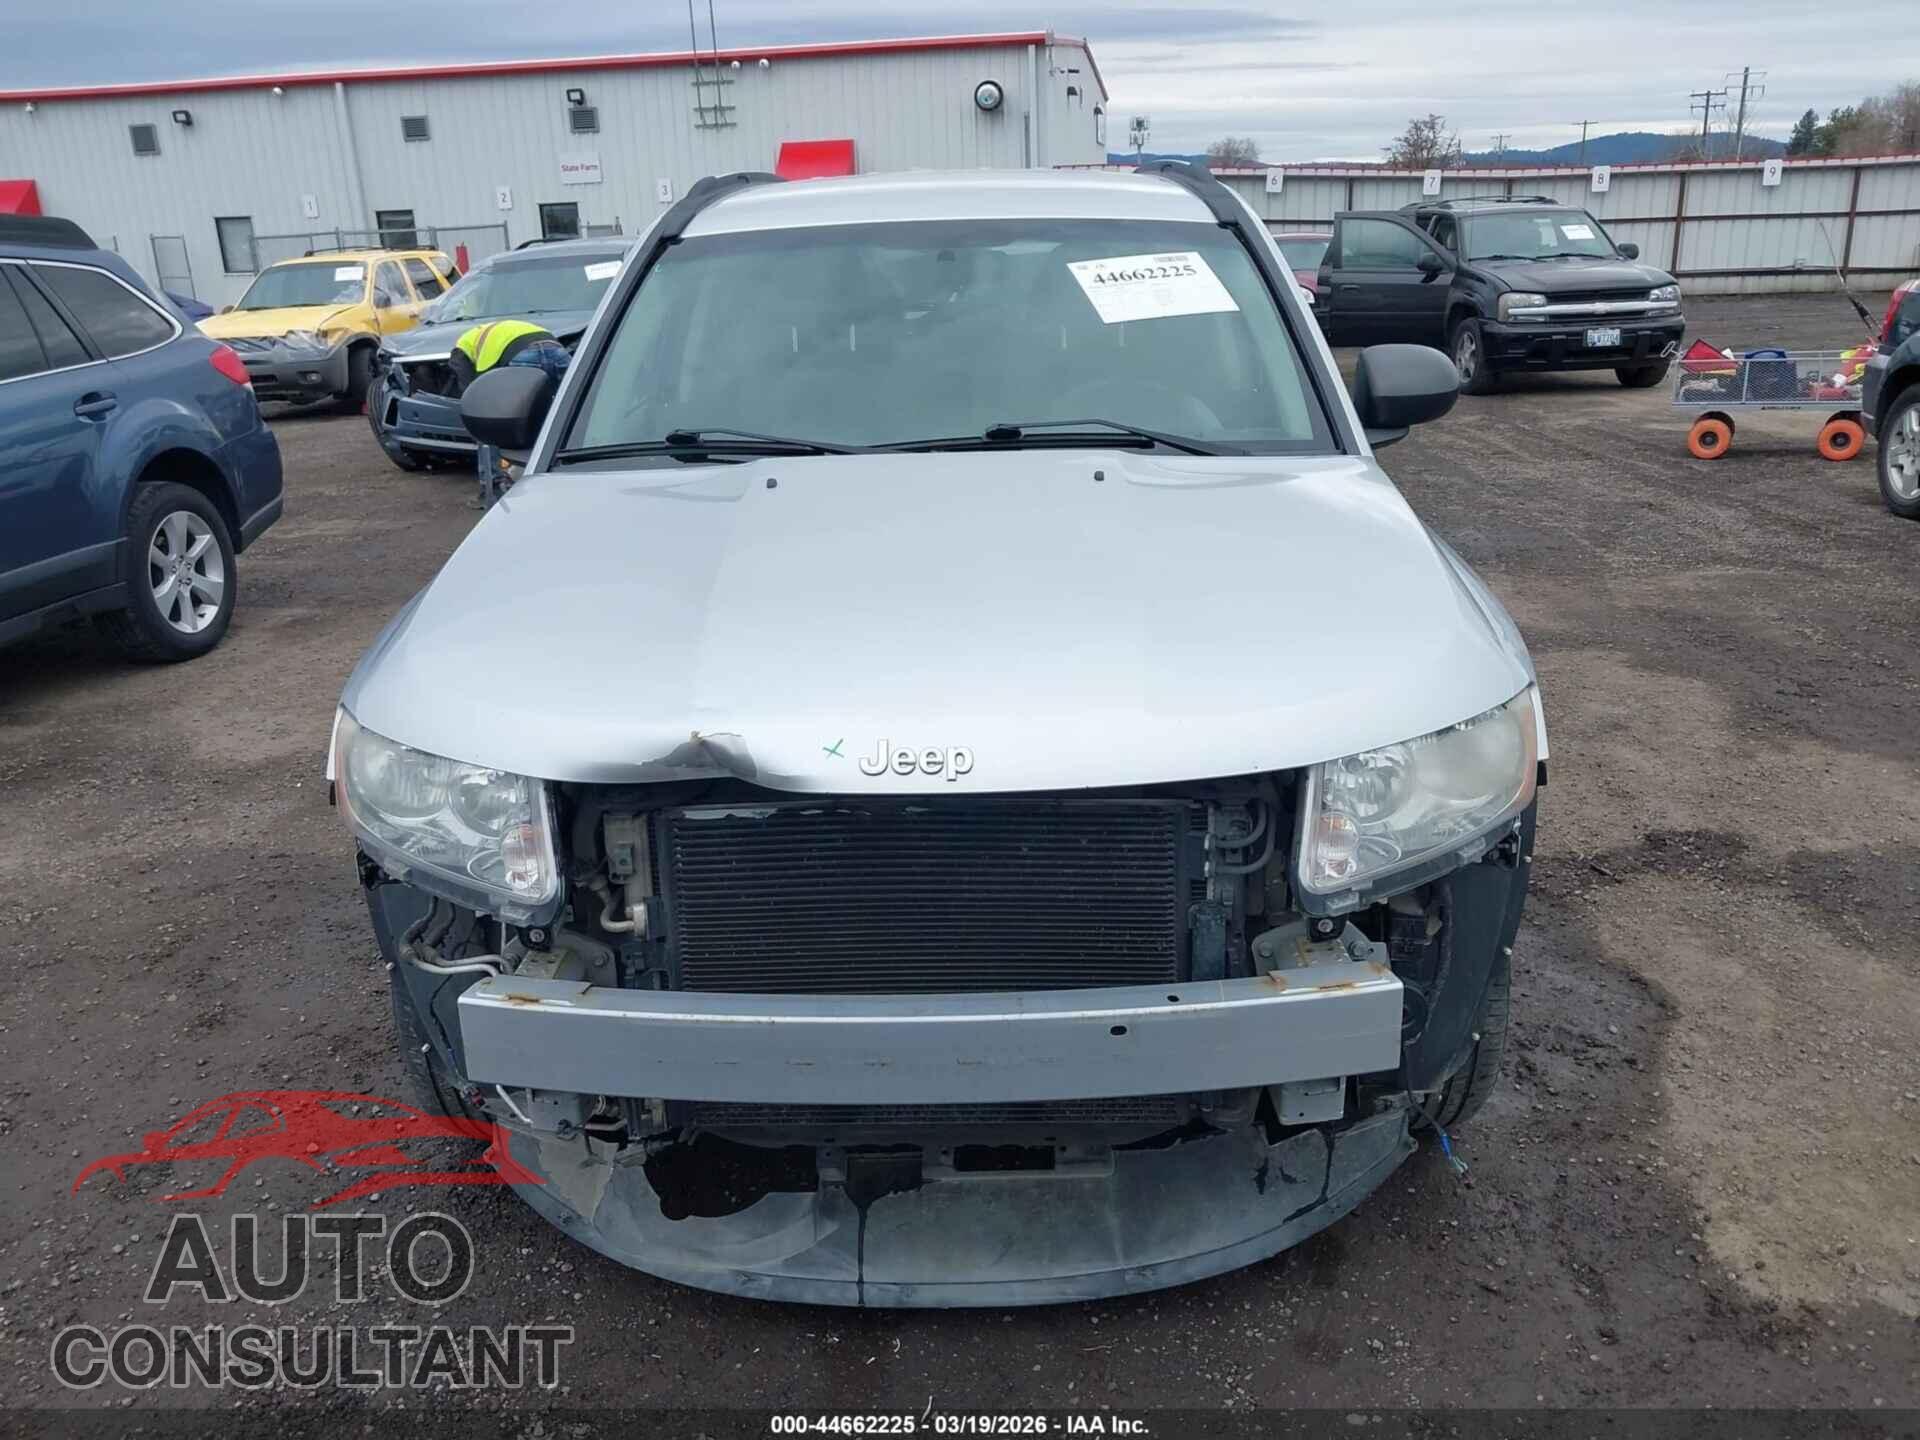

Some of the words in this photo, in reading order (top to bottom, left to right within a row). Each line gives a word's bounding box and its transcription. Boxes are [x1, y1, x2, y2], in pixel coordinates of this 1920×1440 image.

[561, 164, 580, 172] State
[581, 163, 598, 171] Farm
[1769, 166, 1776, 177] 9
[1271, 175, 1278, 185] 6
[1429, 176, 1436, 187] 7
[1597, 173, 1604, 184] 8
[662, 184, 668, 195] 3
[501, 192, 507, 202] 2
[1093, 264, 1197, 285] 44662225
[858, 738, 974, 782] Jeep
